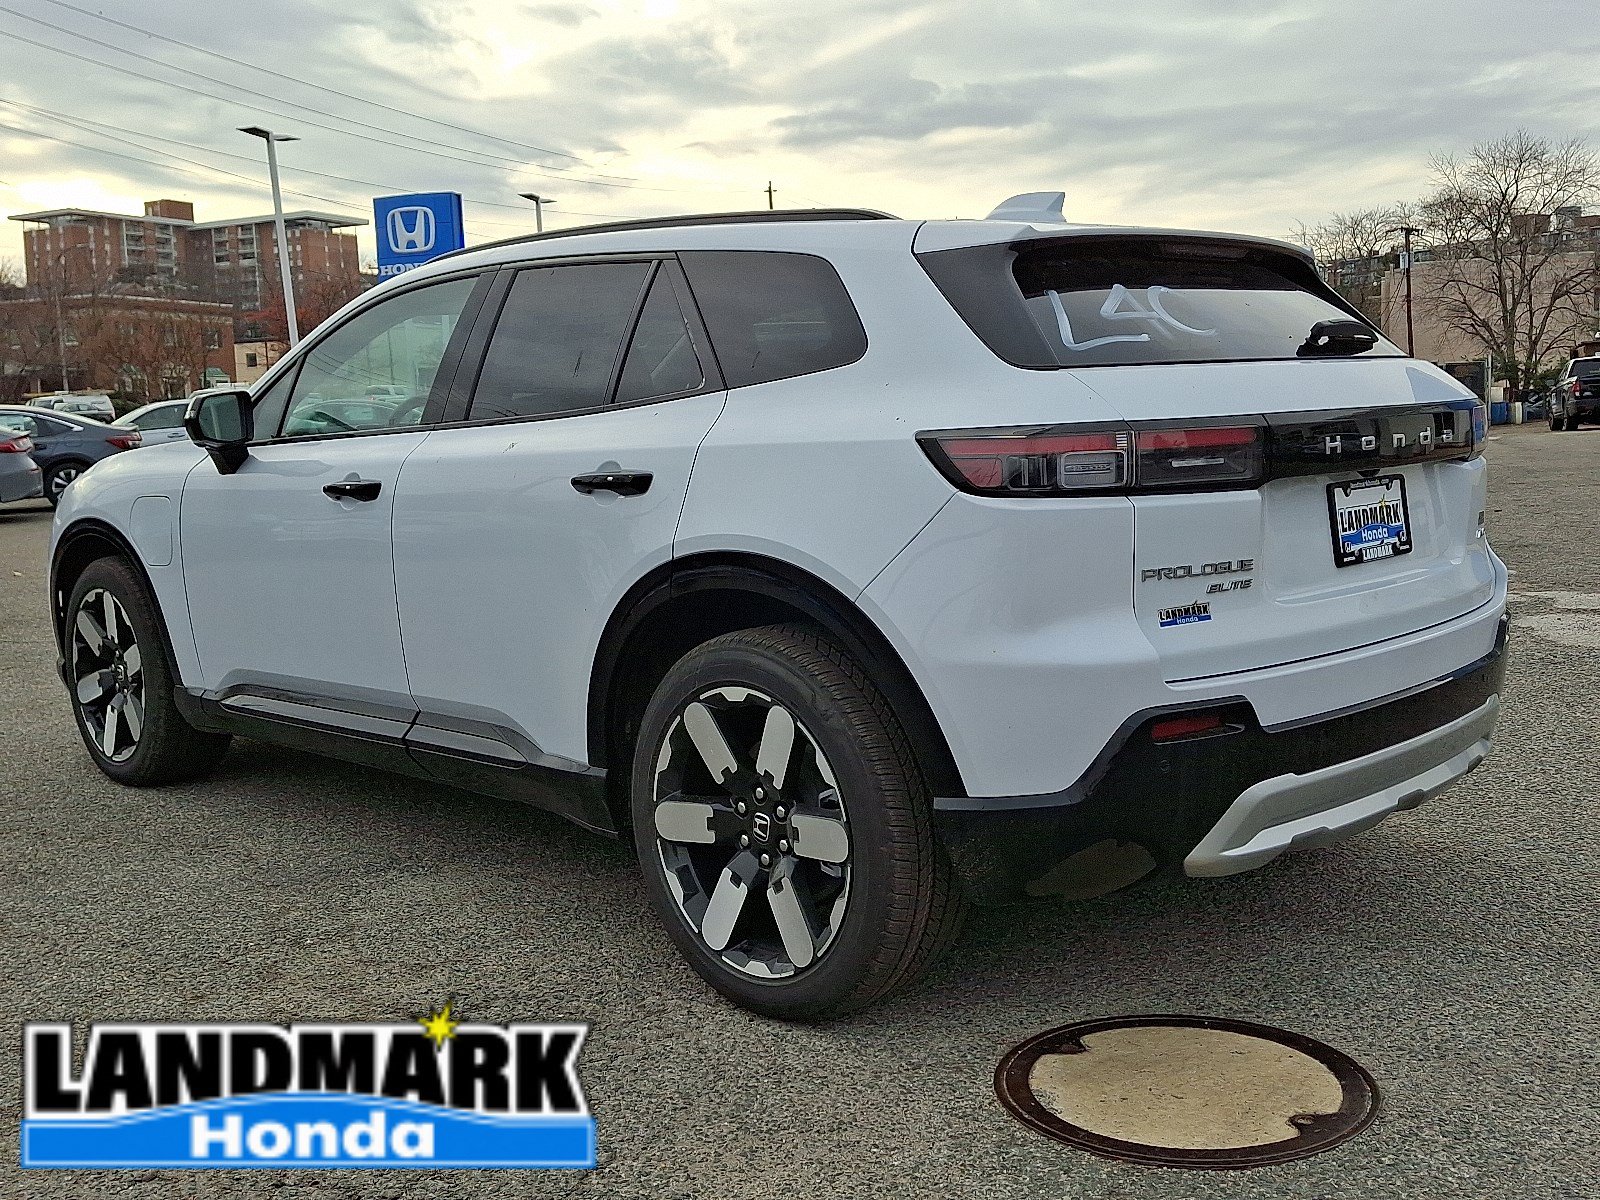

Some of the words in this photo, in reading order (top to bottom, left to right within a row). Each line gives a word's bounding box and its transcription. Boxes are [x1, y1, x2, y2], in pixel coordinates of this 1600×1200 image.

[380, 262, 421, 276] HON
[1325, 426, 1453, 454] Honda
[1339, 501, 1402, 533] LANDMARK
[1361, 526, 1388, 541] Honda
[1362, 544, 1393, 561] LANDMARK
[1141, 559, 1254, 582] PROLOGUE
[1205, 579, 1253, 593] ELITE
[1158, 602, 1209, 621] LANDMARK
[1176, 615, 1199, 624] Honda
